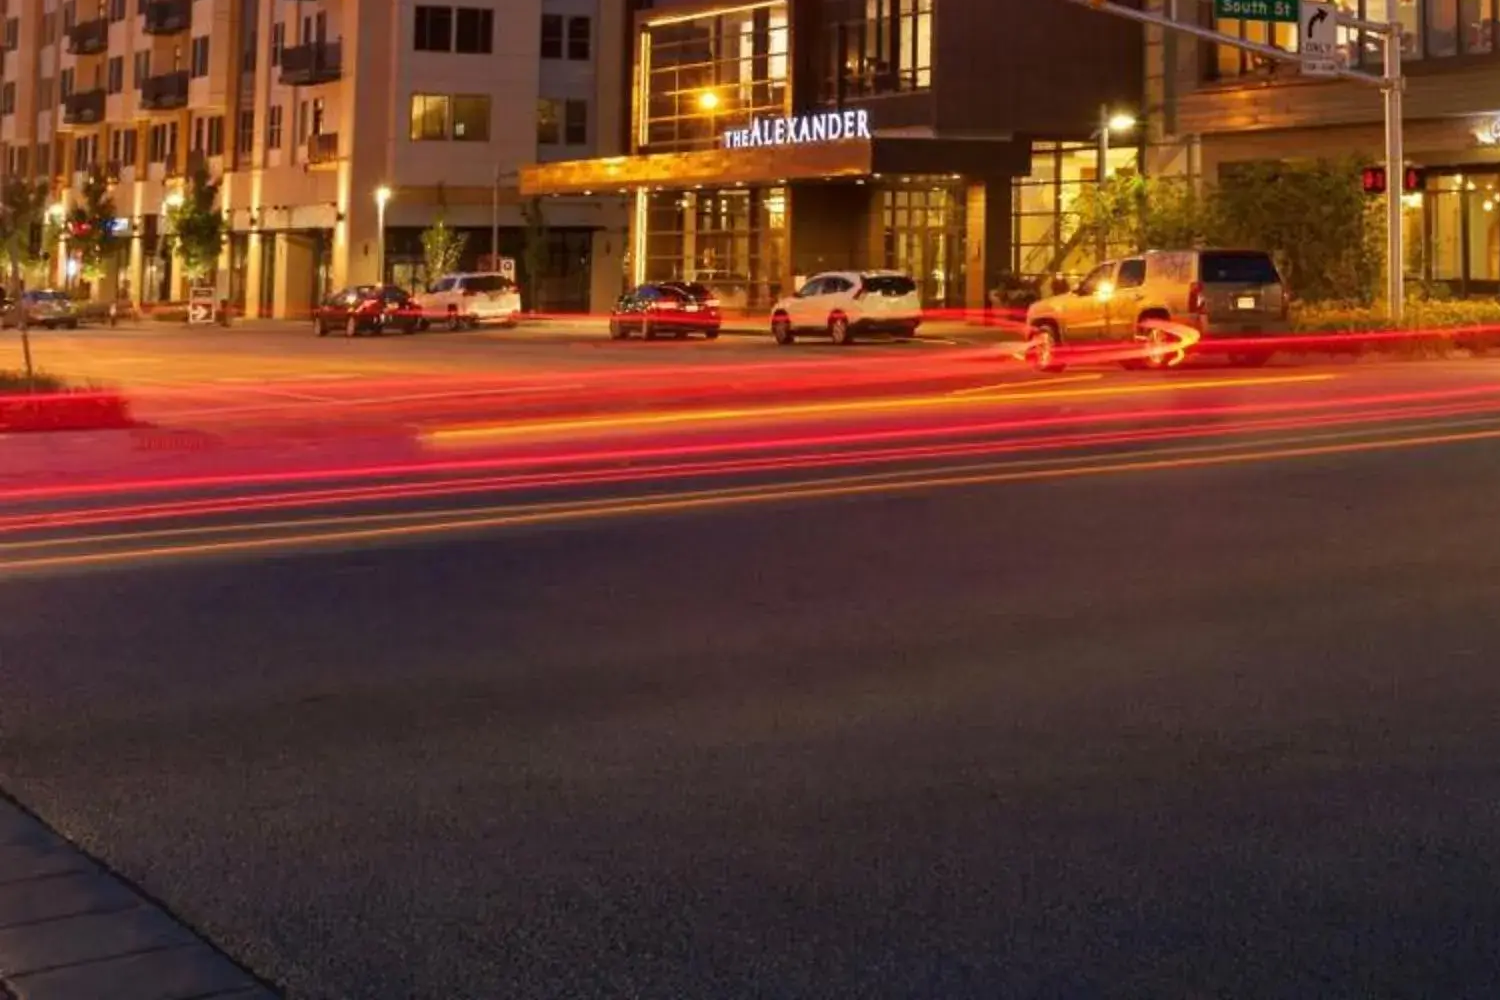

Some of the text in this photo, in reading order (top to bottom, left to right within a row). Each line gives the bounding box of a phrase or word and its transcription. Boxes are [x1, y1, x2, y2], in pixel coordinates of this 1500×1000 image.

[1274, 0, 1291, 17] St
[724, 110, 871, 149] THE ALEXANDER
